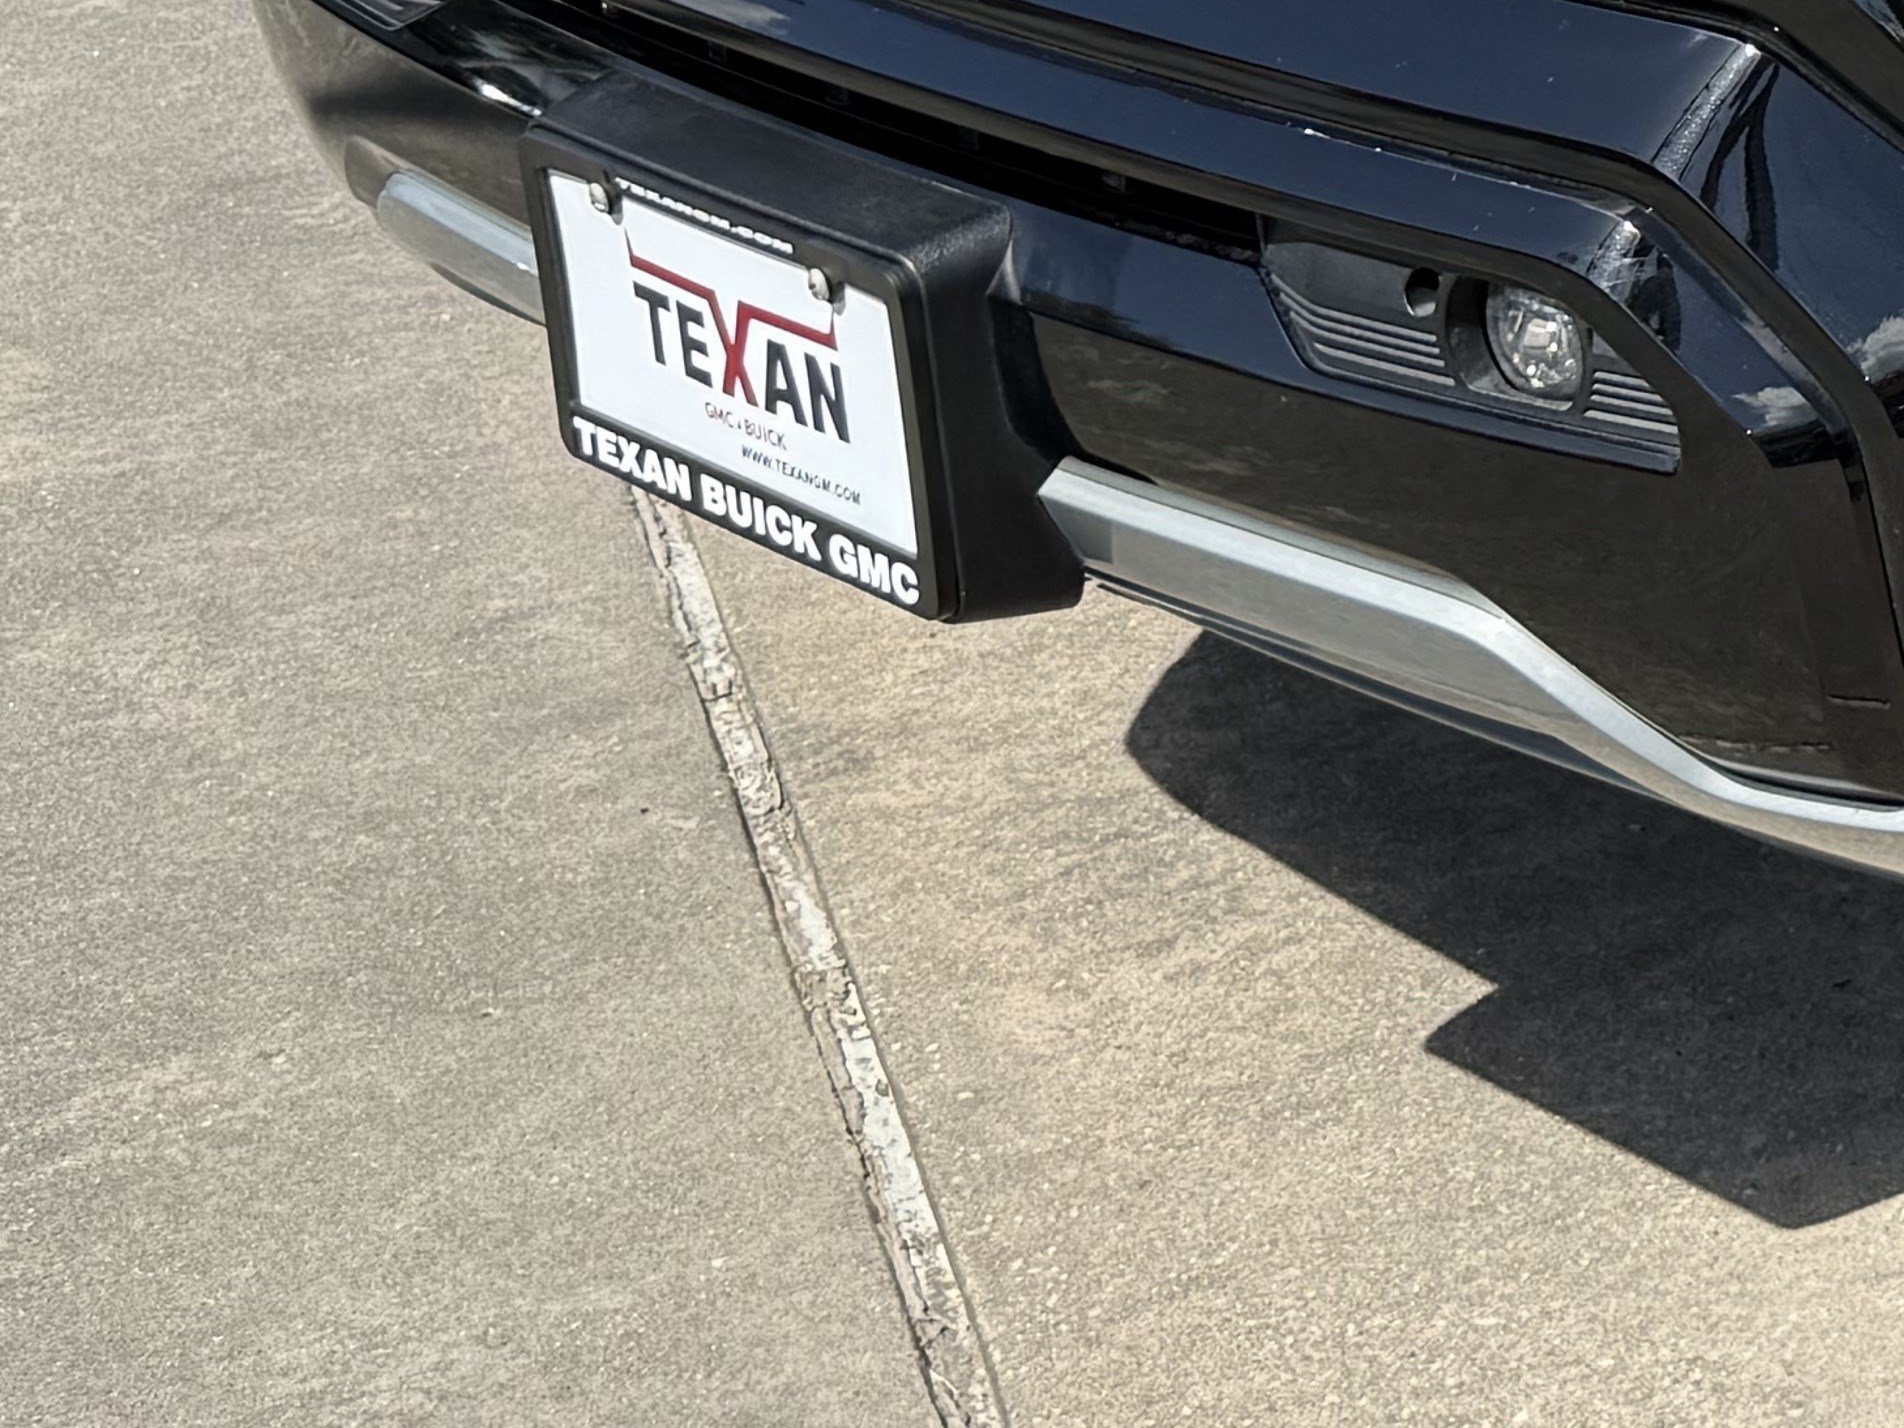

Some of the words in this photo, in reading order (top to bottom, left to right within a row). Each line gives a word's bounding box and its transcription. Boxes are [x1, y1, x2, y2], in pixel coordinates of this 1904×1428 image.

[626, 229, 851, 445] TEXAN
[705, 401, 734, 429] GMC
[744, 418, 787, 450] BUICK
[573, 416, 693, 502] TEXAN
[700, 471, 824, 563] BUICK
[828, 532, 921, 606] GMC
